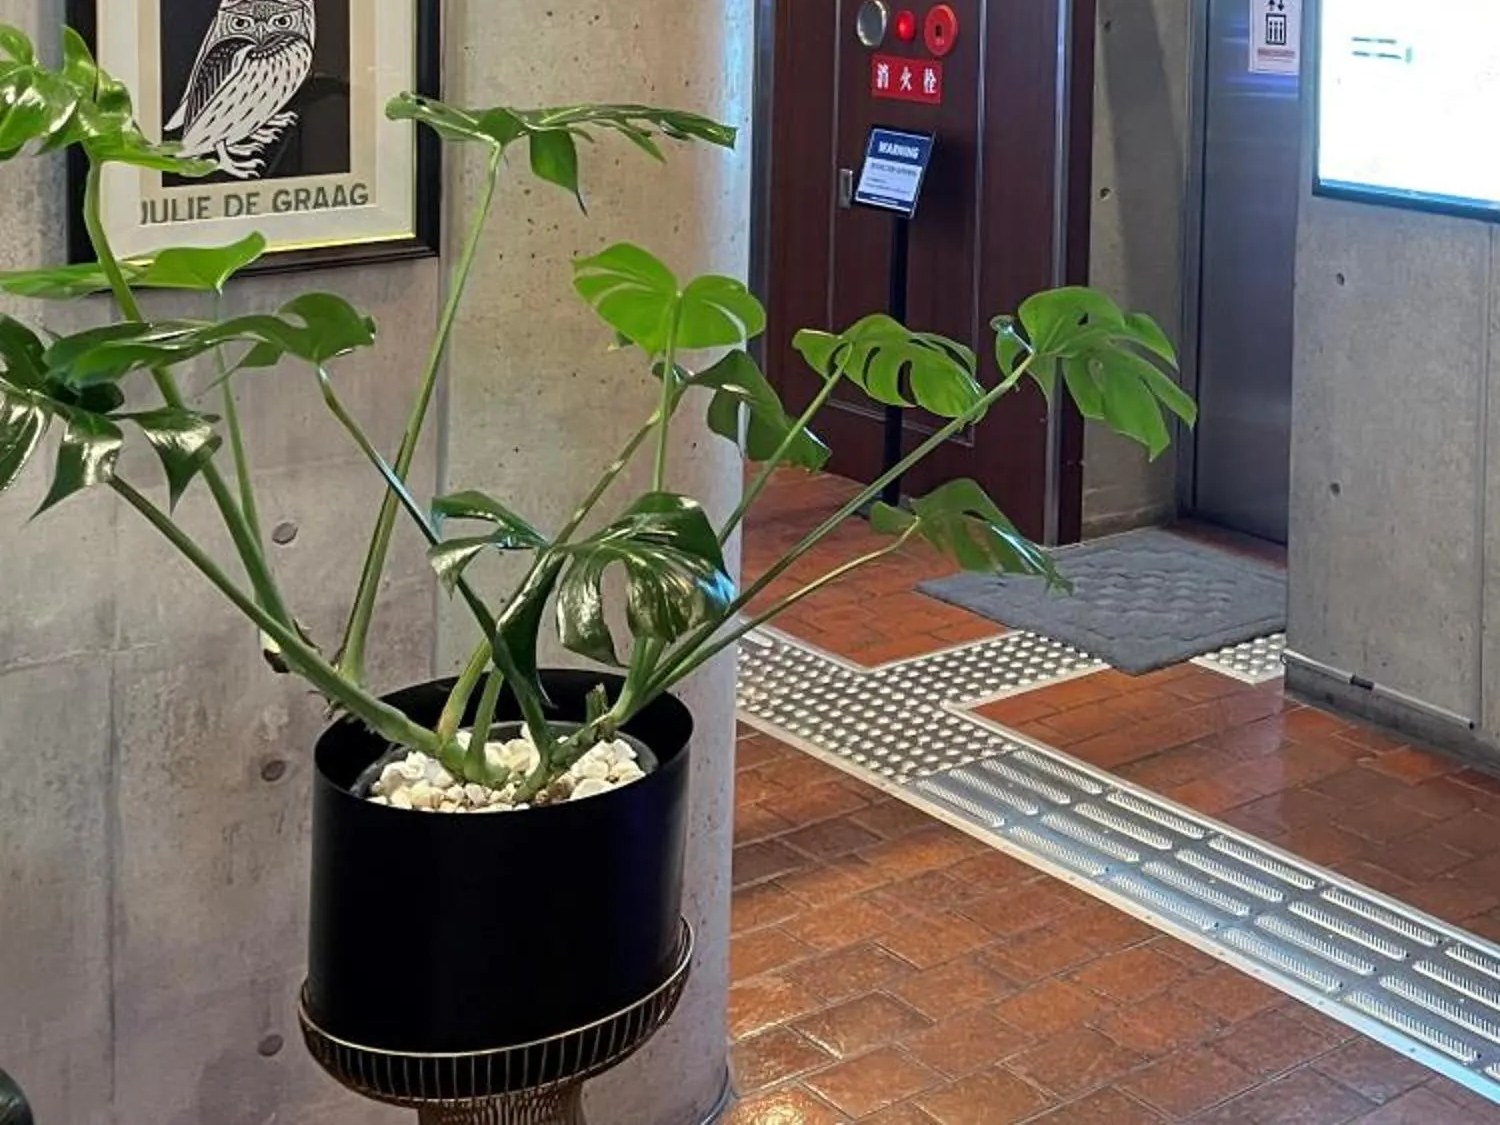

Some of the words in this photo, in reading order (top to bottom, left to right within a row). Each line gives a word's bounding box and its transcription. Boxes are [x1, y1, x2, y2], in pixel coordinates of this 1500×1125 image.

[876, 62, 937, 94] 消火栓
[878, 140, 920, 160] WARNING
[140, 196, 212, 225] JULIE
[223, 192, 261, 217] DE
[271, 182, 369, 214] GRAAG
